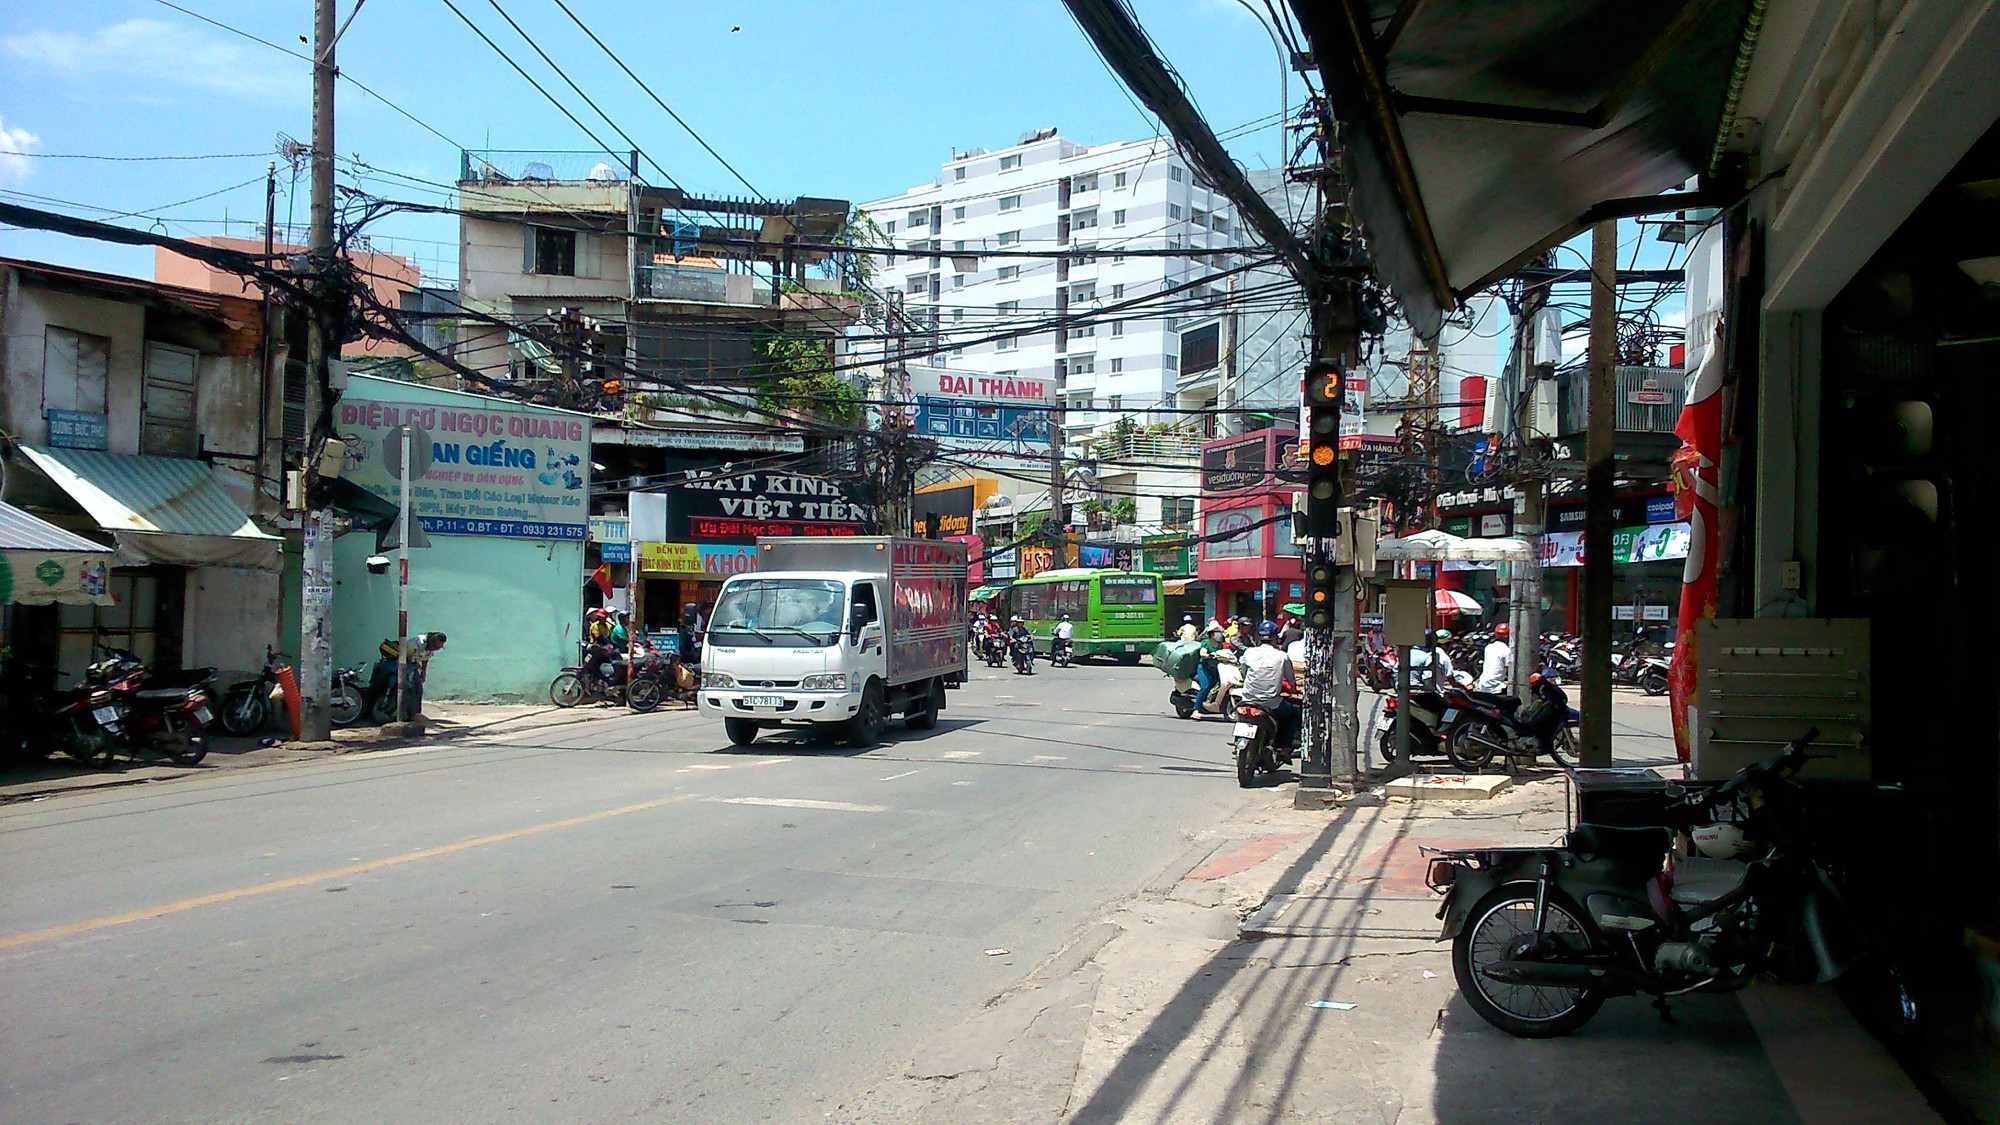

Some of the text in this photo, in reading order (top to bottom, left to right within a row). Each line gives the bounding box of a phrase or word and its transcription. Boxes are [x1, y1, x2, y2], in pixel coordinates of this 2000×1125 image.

[979, 376, 1043, 398] THÀNH
[1324, 373, 1338, 398] 2
[341, 401, 399, 430] ĐIỆN
[441, 411, 503, 437] NGỌC
[508, 417, 582, 441] QUANG
[466, 440, 536, 469] GIẾNG
[719, 495, 867, 521] VIỆT TIẾN
[1647, 502, 1674, 512] coolpad
[467, 522, 491, 532] Q.BT
[501, 524, 514, 533] ĐT
[523, 525, 545, 535] 0933
[548, 526, 563, 536] 231
[567, 527, 583, 537] 575
